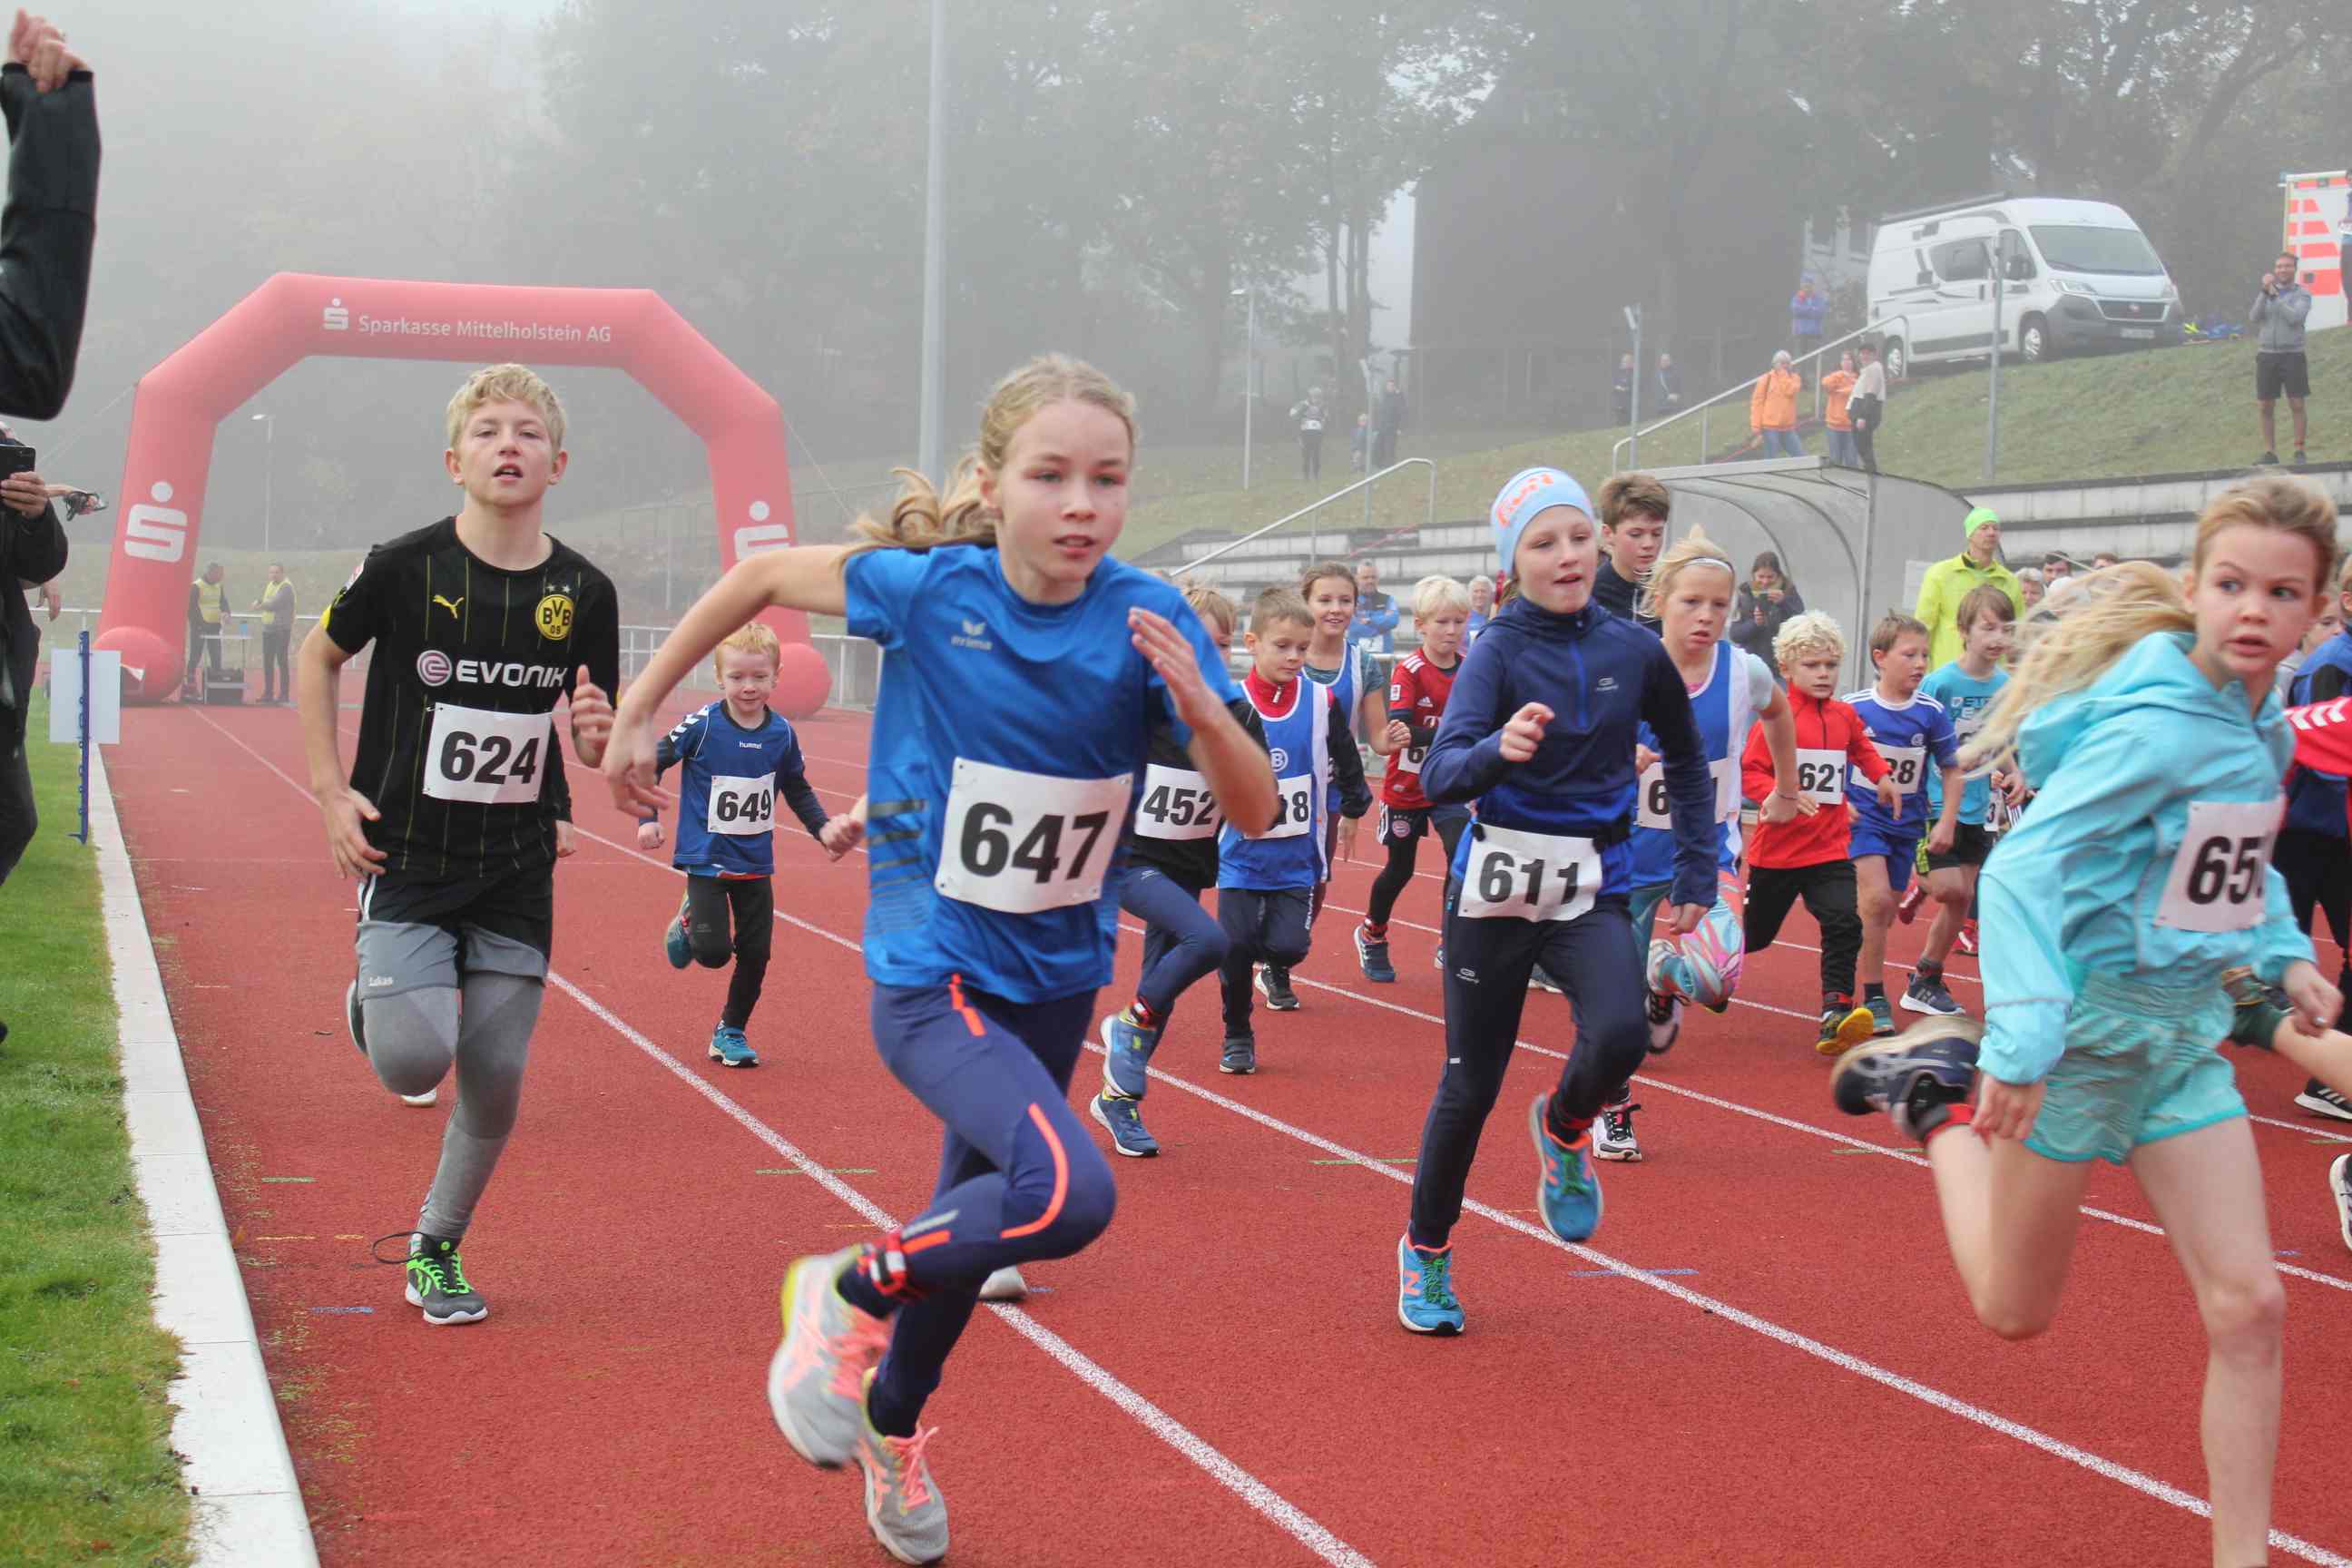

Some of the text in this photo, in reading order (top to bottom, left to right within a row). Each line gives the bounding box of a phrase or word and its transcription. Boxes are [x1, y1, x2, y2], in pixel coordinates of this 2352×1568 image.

[358, 315, 451, 338] Sparkasse
[456, 318, 582, 341] Mittelholstein
[586, 325, 611, 343] AG
[544, 600, 572, 627] BVB
[440, 730, 540, 784] 624
[717, 789, 772, 823] 649
[1142, 785, 1213, 826] 452
[960, 802, 1109, 885] 647
[1479, 851, 1581, 906] 611
[2187, 834, 2266, 905] 65
